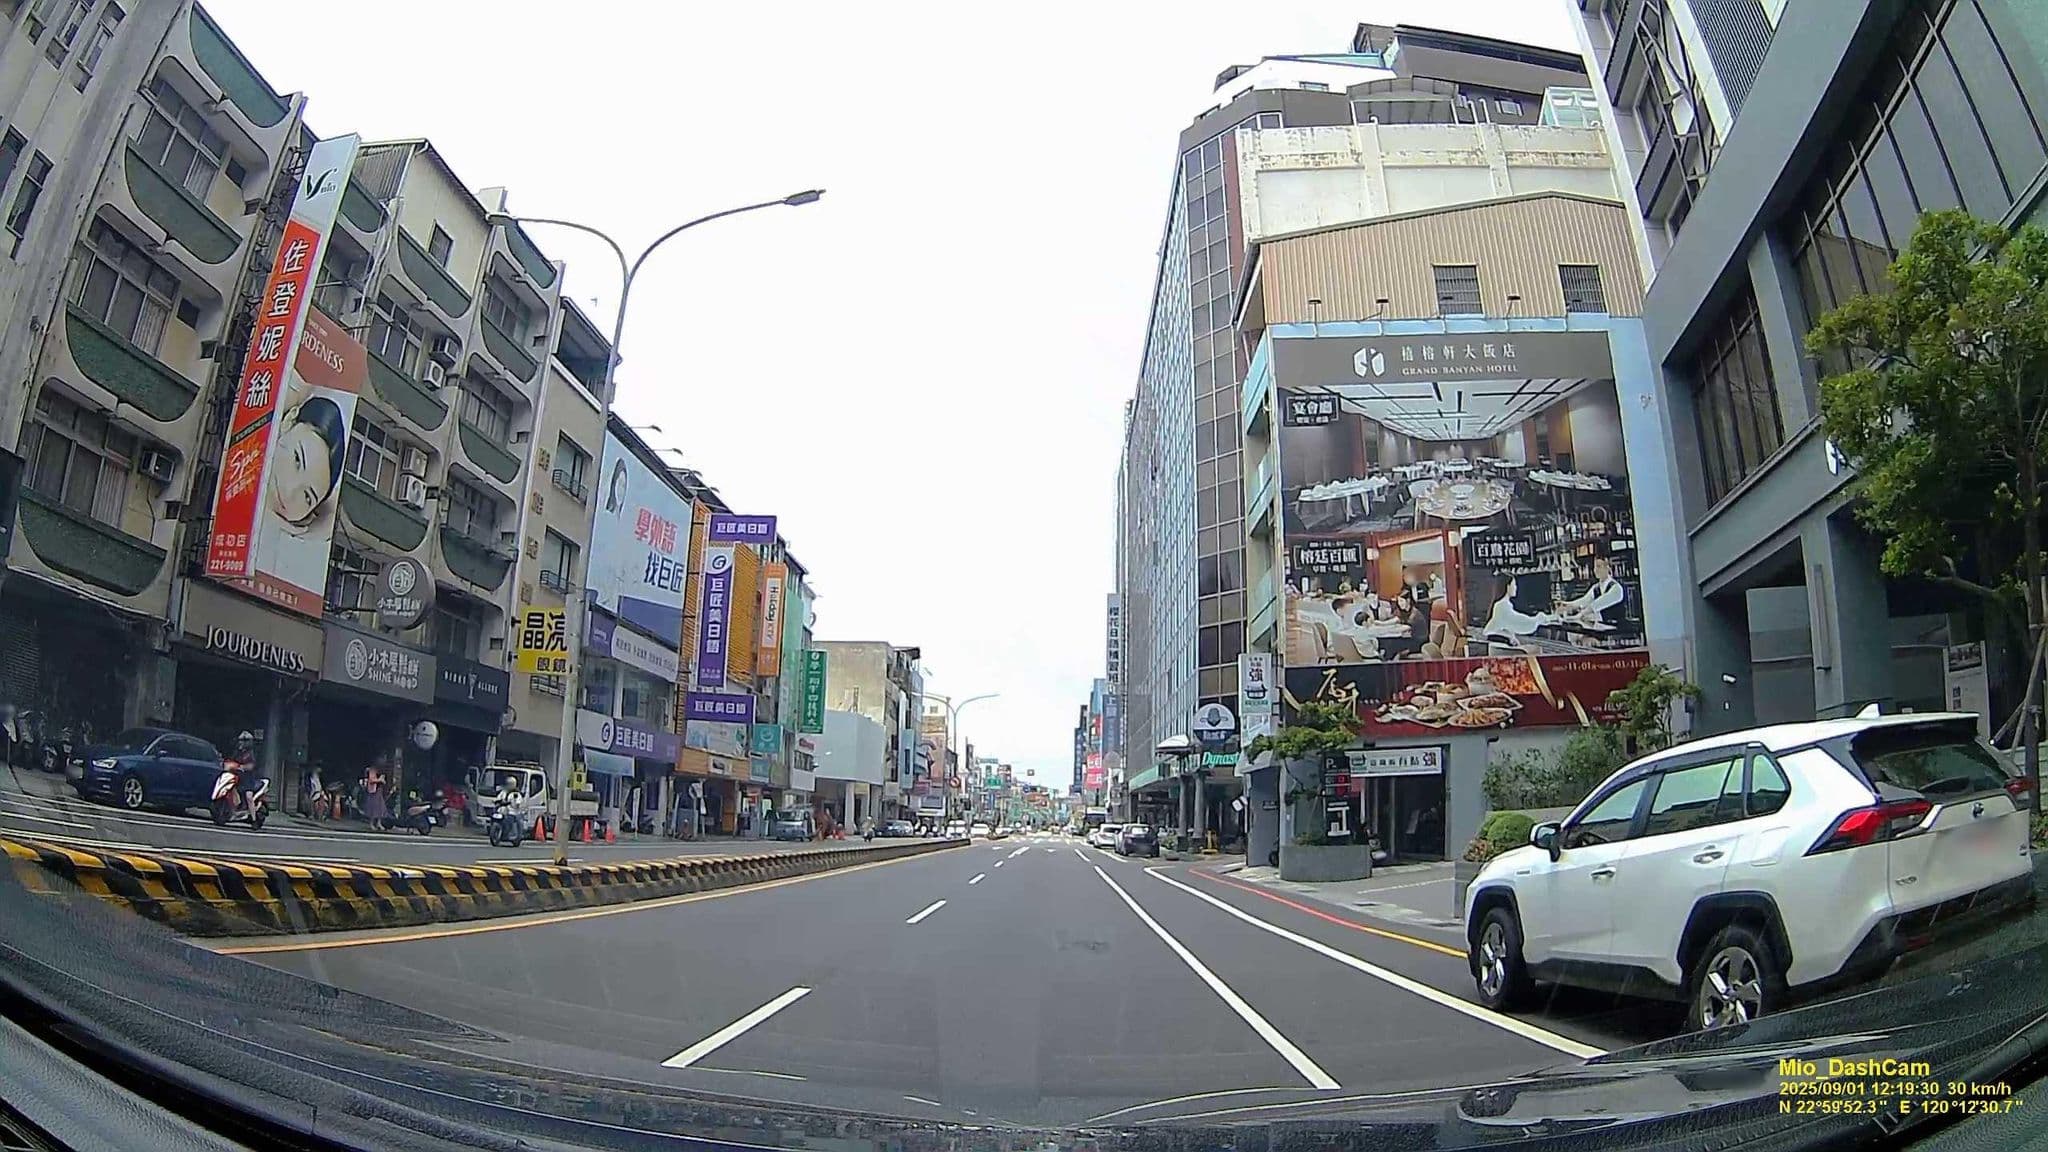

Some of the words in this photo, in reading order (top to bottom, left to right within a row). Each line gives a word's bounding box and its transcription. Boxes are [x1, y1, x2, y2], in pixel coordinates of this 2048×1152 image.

[244, 238, 309, 408] 佐登妮絲
[1402, 367, 1438, 376] GRAND
[1443, 365, 1483, 375] BANYAN
[1487, 364, 1519, 373] HOTEL
[644, 552, 685, 593] 找巨匠
[706, 578, 724, 654] 巨匠美日語
[206, 625, 305, 673] JOURDENESS
[368, 648, 419, 676] 小木屋鬆餅
[368, 667, 392, 683] SHINE
[537, 657, 567, 673] 眼鏡
[694, 700, 747, 714] 巨匠美日語
[615, 725, 654, 752] 巨匠美日語
